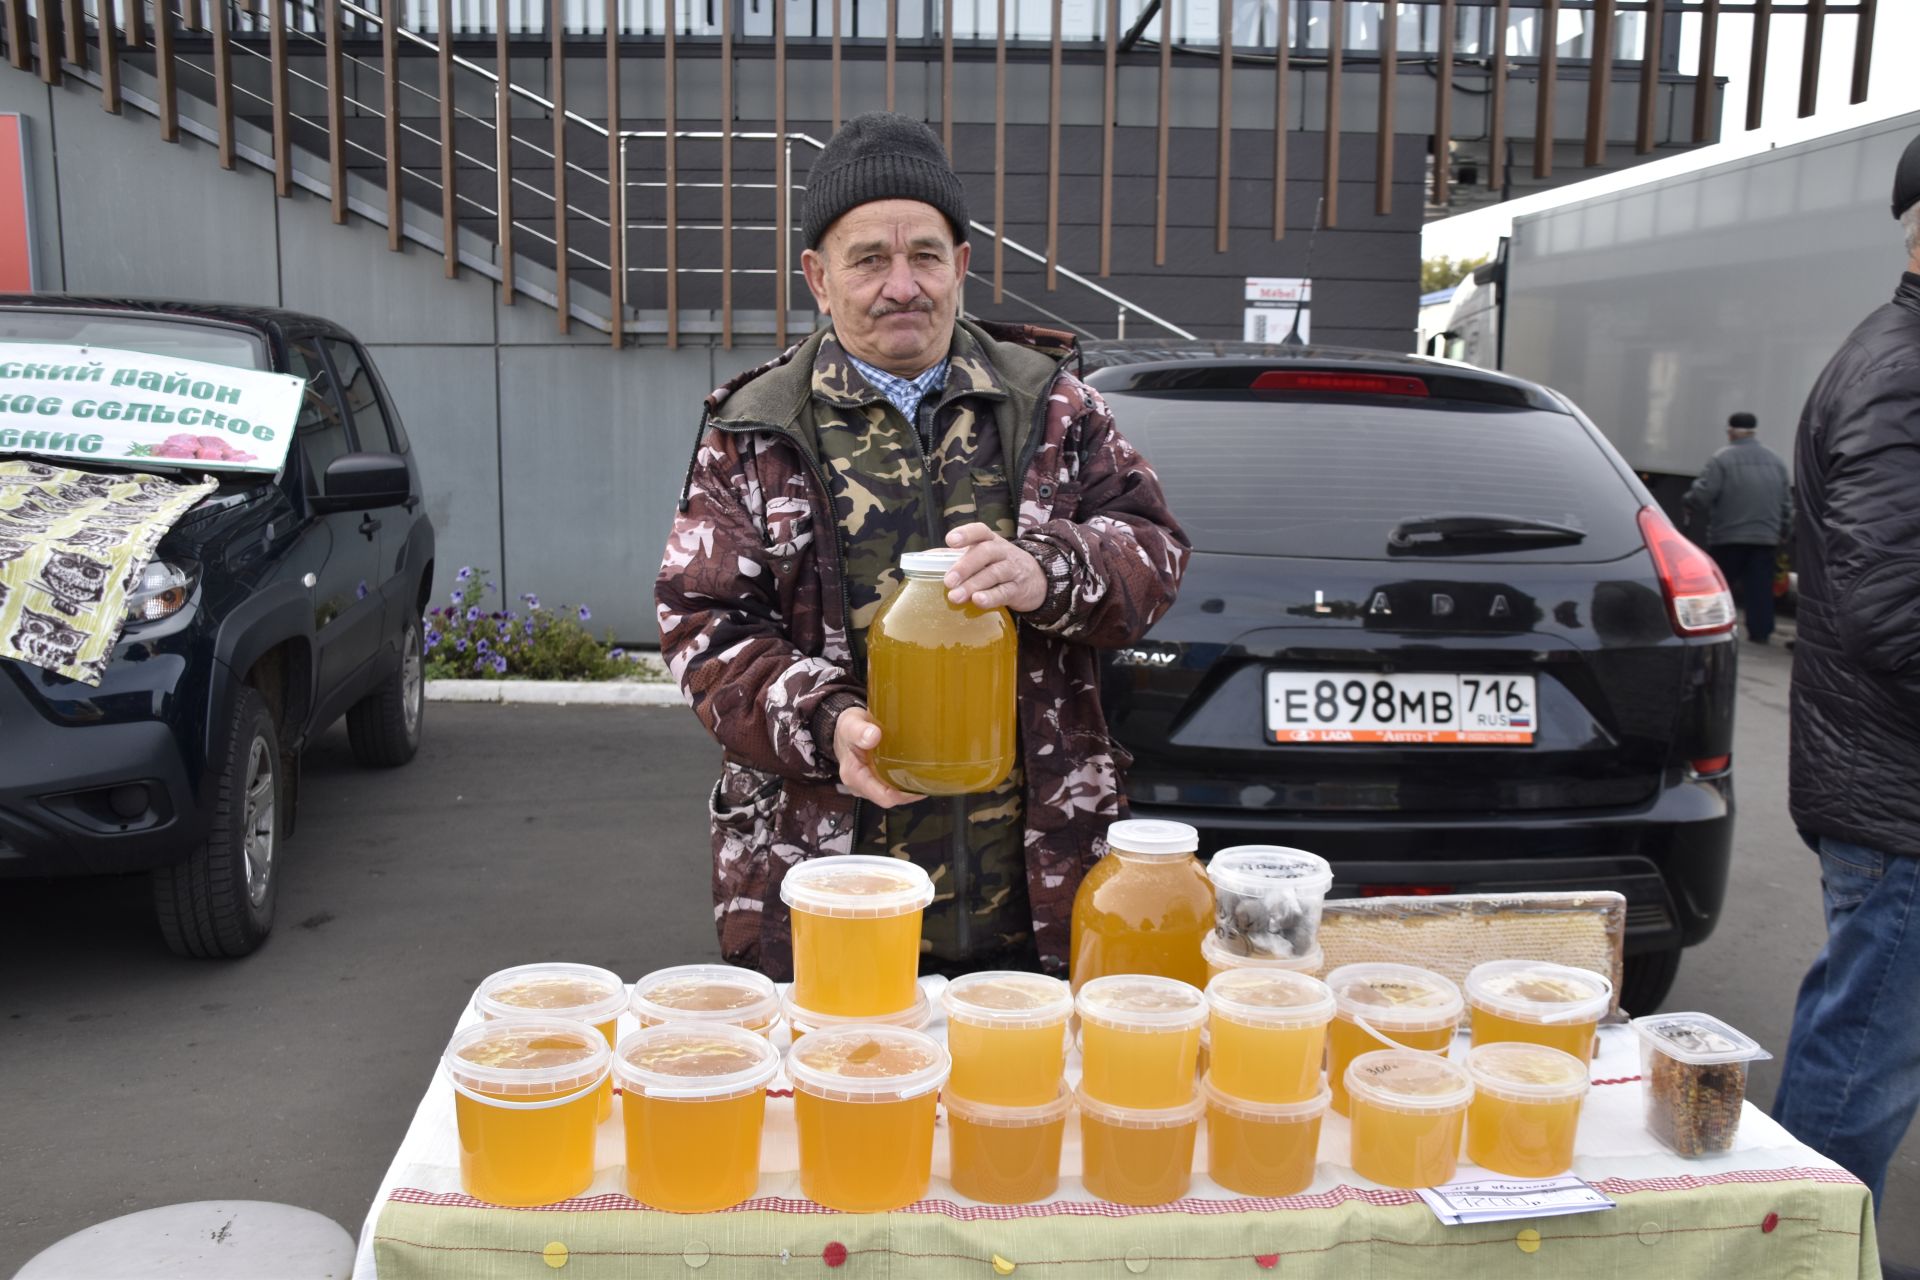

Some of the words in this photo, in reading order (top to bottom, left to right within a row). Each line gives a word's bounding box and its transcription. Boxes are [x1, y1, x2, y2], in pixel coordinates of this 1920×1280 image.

[110, 368, 242, 405] район
[72, 400, 276, 441] сельское
[1315, 590, 1511, 617] LADA
[1112, 648, 1176, 667] XRAY
[1463, 681, 1524, 713] 716
[1478, 715, 1507, 726] RUS
